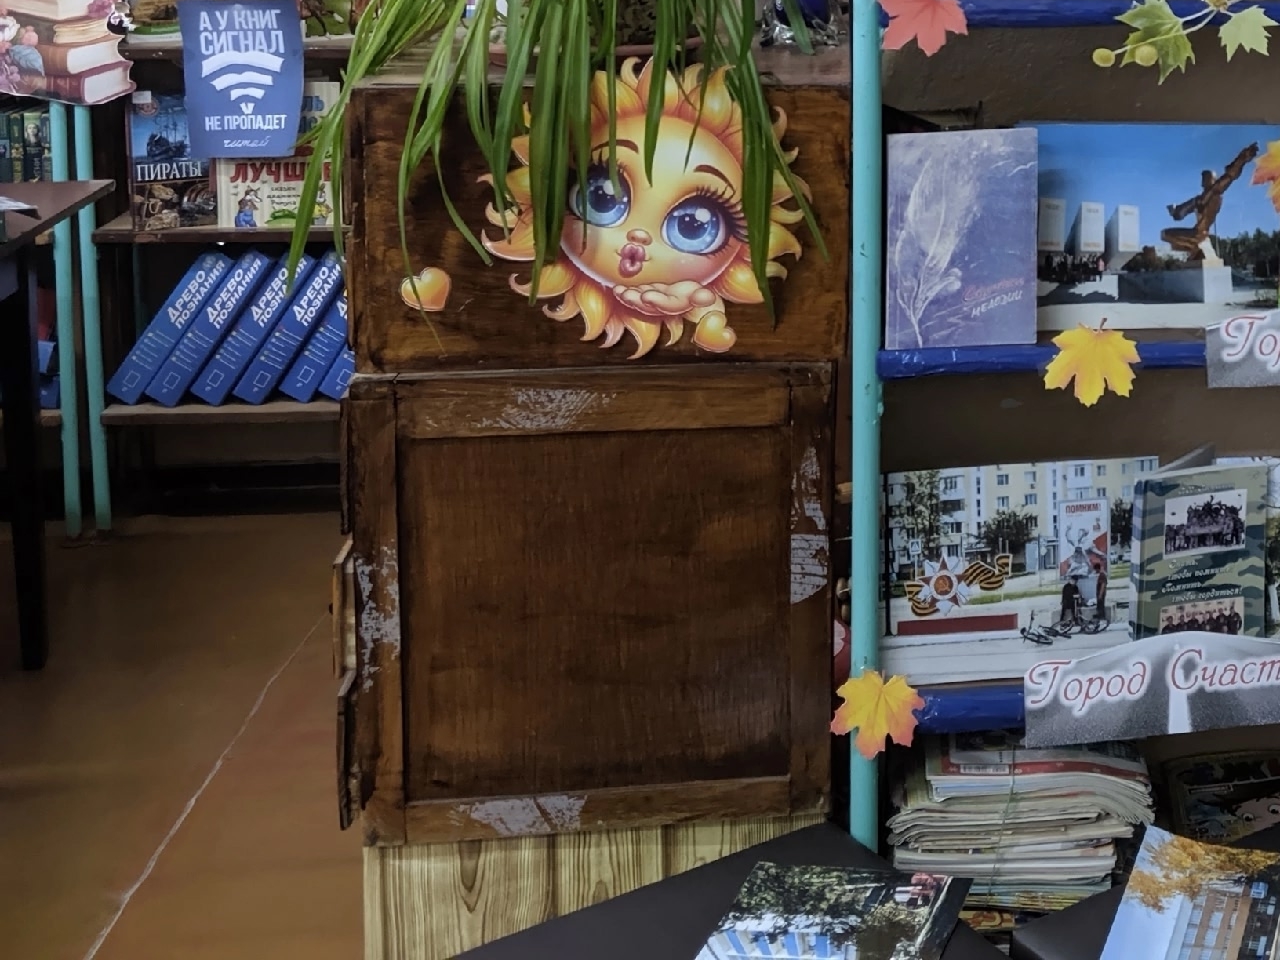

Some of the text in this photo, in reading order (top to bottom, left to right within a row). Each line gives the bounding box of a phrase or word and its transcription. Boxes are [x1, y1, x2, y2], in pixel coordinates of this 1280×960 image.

[199, 9, 281, 31] А У КНИГ
[200, 30, 285, 55] СИГНАЛ
[205, 116, 221, 131] НЕ
[223, 115, 287, 131] ПРОПАДЕТ
[136, 161, 203, 182] ПИРАТЫ
[230, 161, 332, 183] ЛУЧШЕ
[167, 270, 207, 324] ДРЕВО
[174, 259, 226, 330] ПОЗНАНИЯ
[206, 269, 244, 324] ДРЕВО
[213, 258, 263, 330] ПОЗНАНИЯ
[250, 267, 289, 323] ДРЕВО
[257, 257, 308, 328] ПОЗНАИЯ
[292, 266, 329, 323] ДРЕВО
[300, 263, 343, 327] ПОЗНАНИ
[1027, 660, 1147, 712] Город
